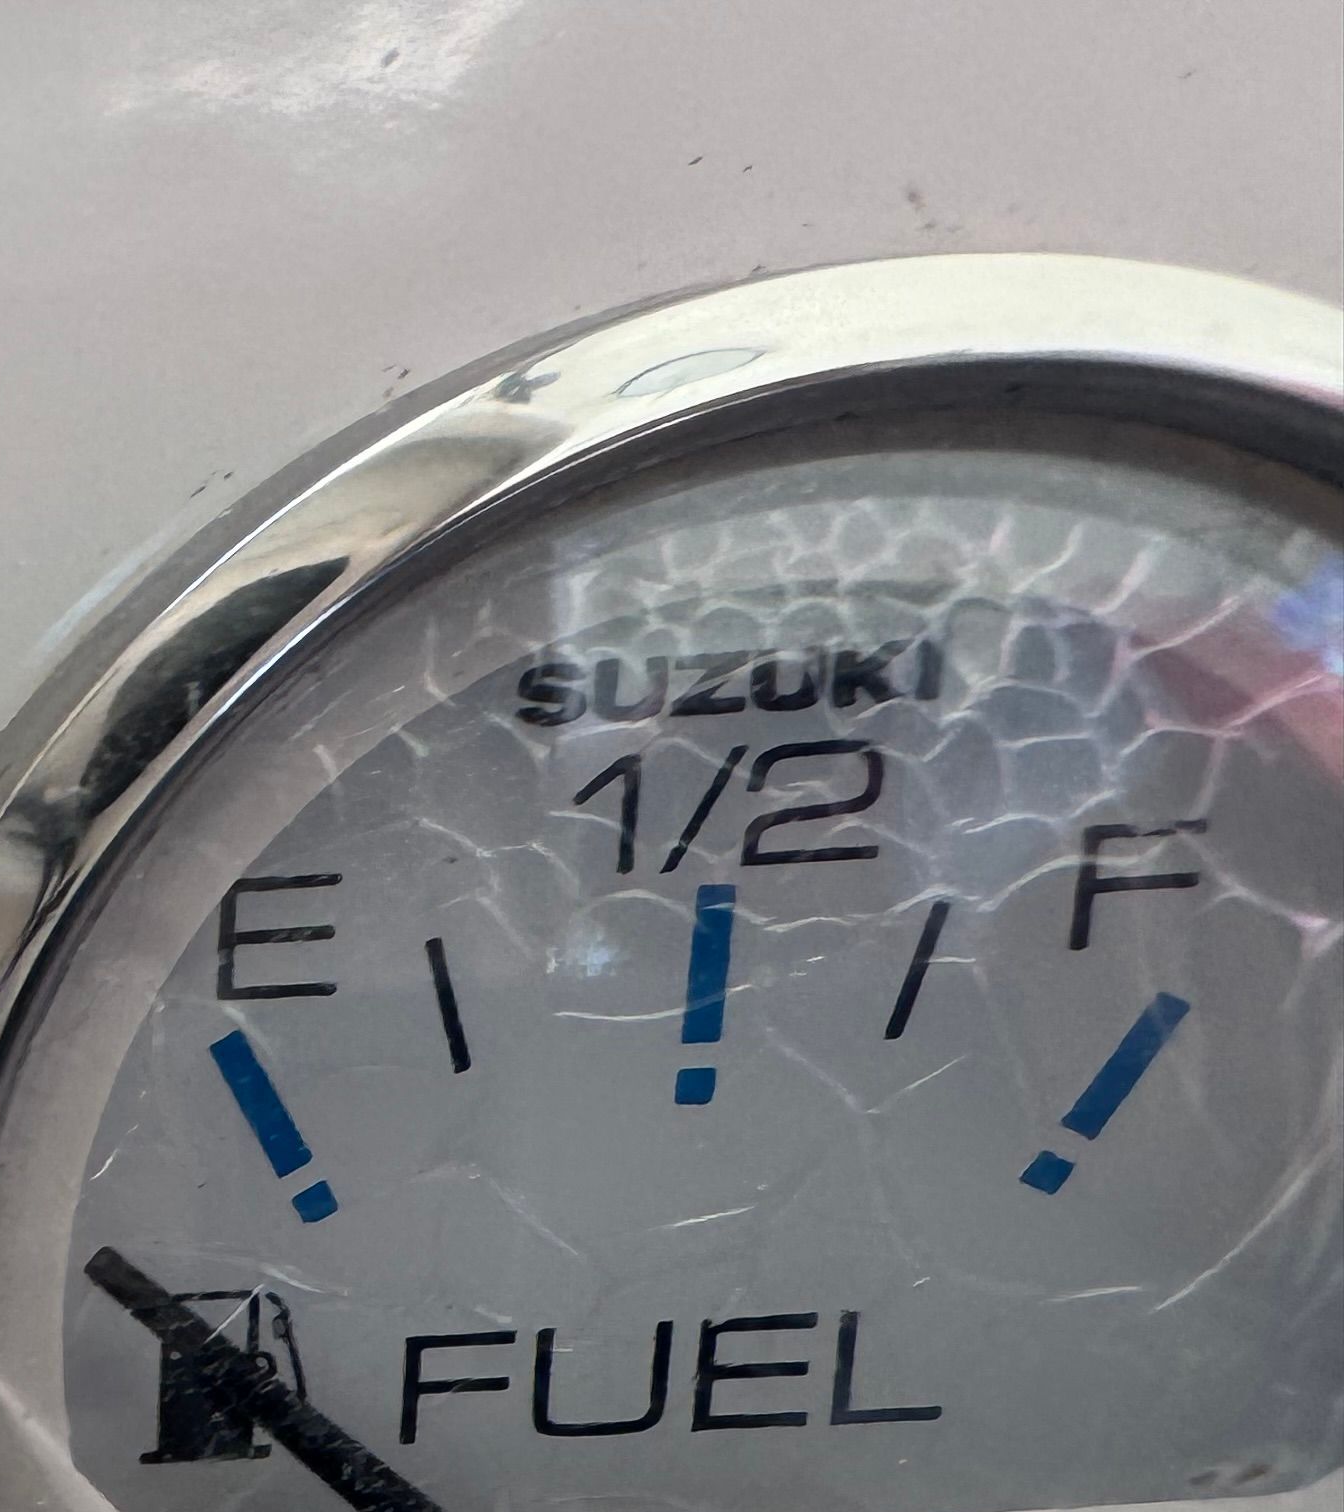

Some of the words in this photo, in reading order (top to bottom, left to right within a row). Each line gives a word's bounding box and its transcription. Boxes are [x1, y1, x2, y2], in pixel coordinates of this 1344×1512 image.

[516, 638, 943, 727] SUZUKI
[574, 738, 886, 874] 1/2
[215, 872, 343, 999] E
[1068, 818, 1206, 951] F
[398, 1308, 942, 1443] FUEL
